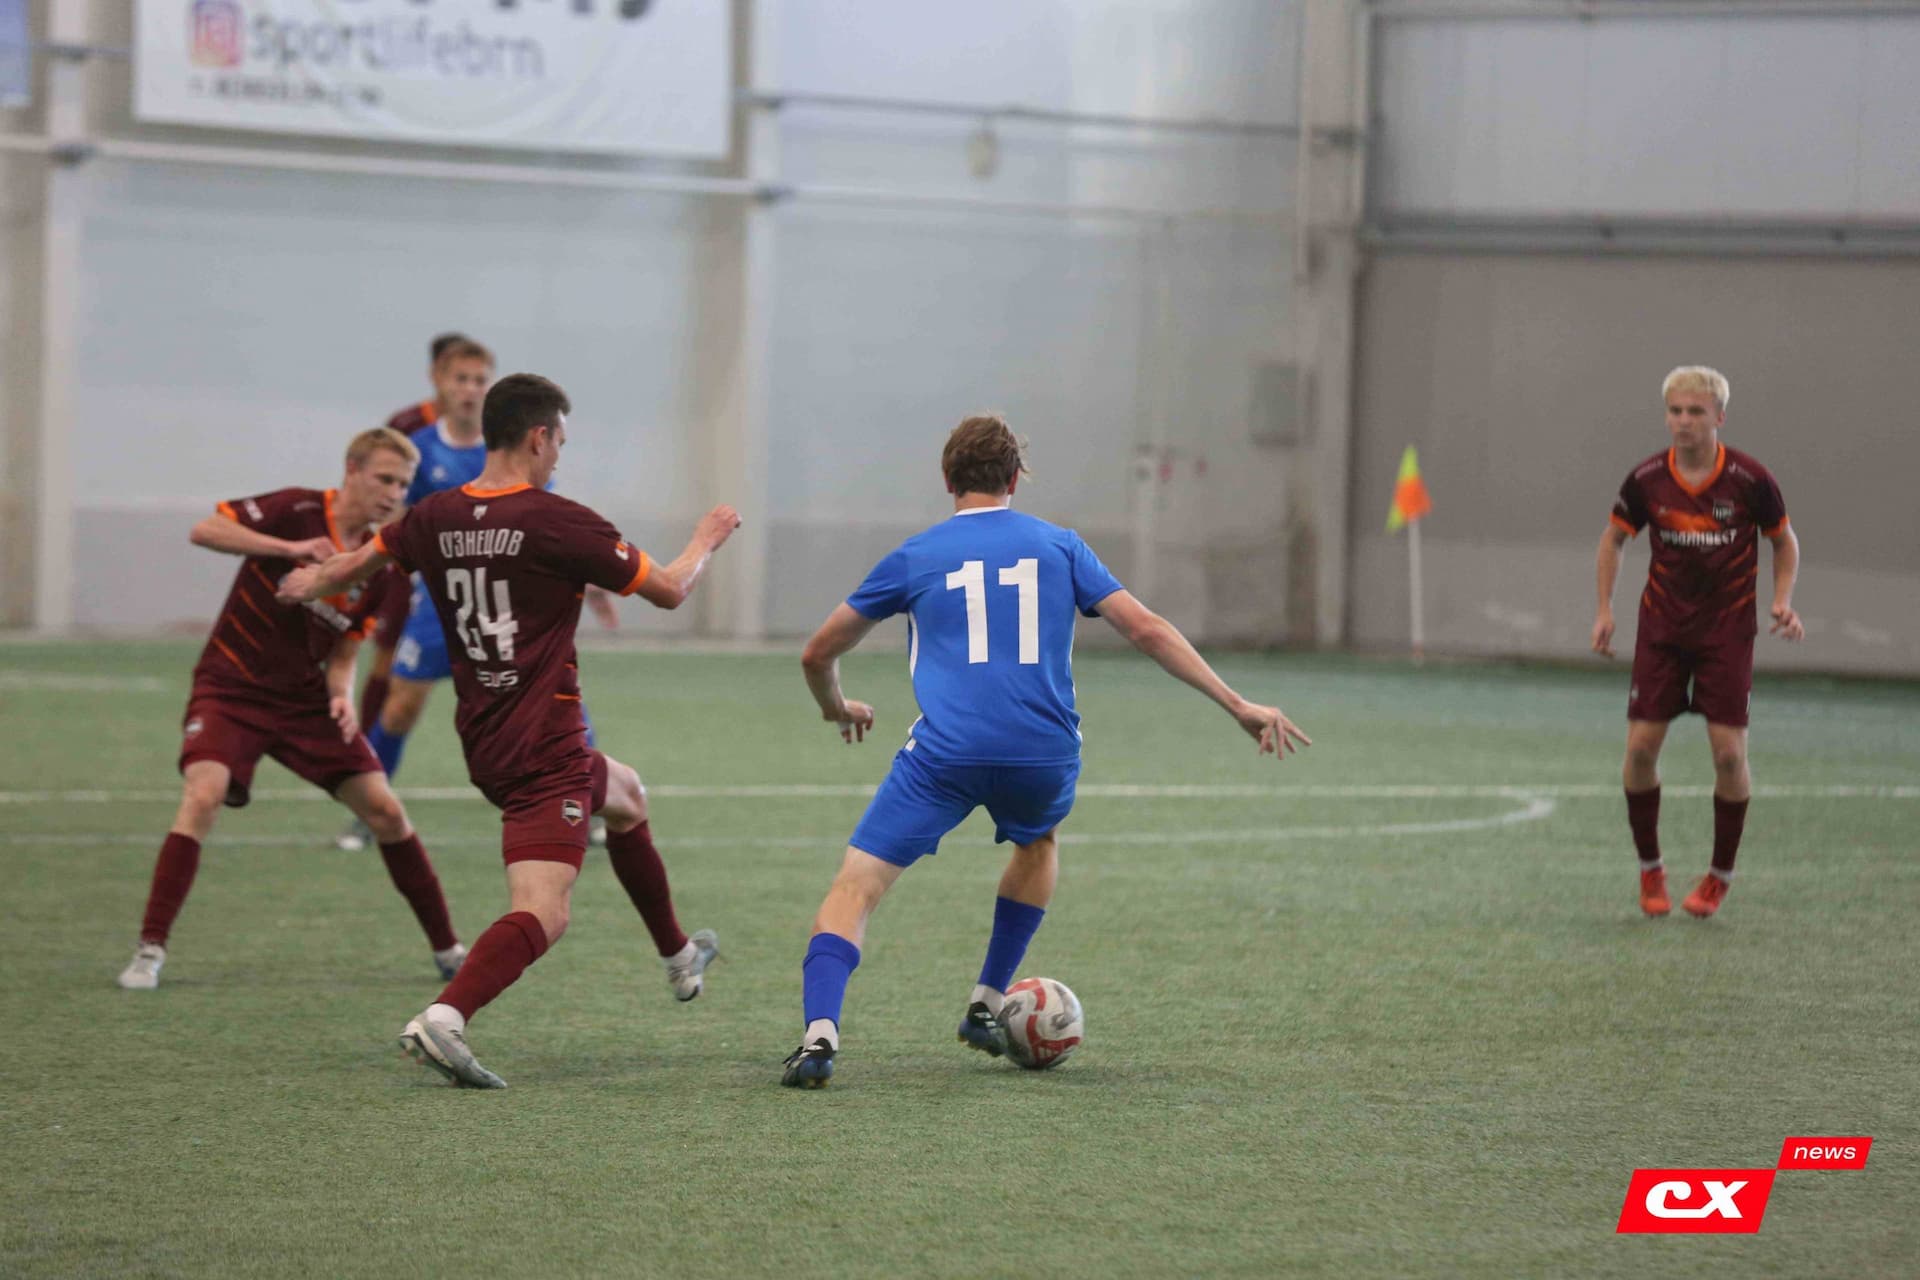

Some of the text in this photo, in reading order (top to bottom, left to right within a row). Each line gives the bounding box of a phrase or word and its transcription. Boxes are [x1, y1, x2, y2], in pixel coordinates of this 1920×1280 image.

[438, 528, 525, 559] УЗНЕЦОВ
[446, 567, 519, 661] 24
[946, 558, 1039, 664] 11
